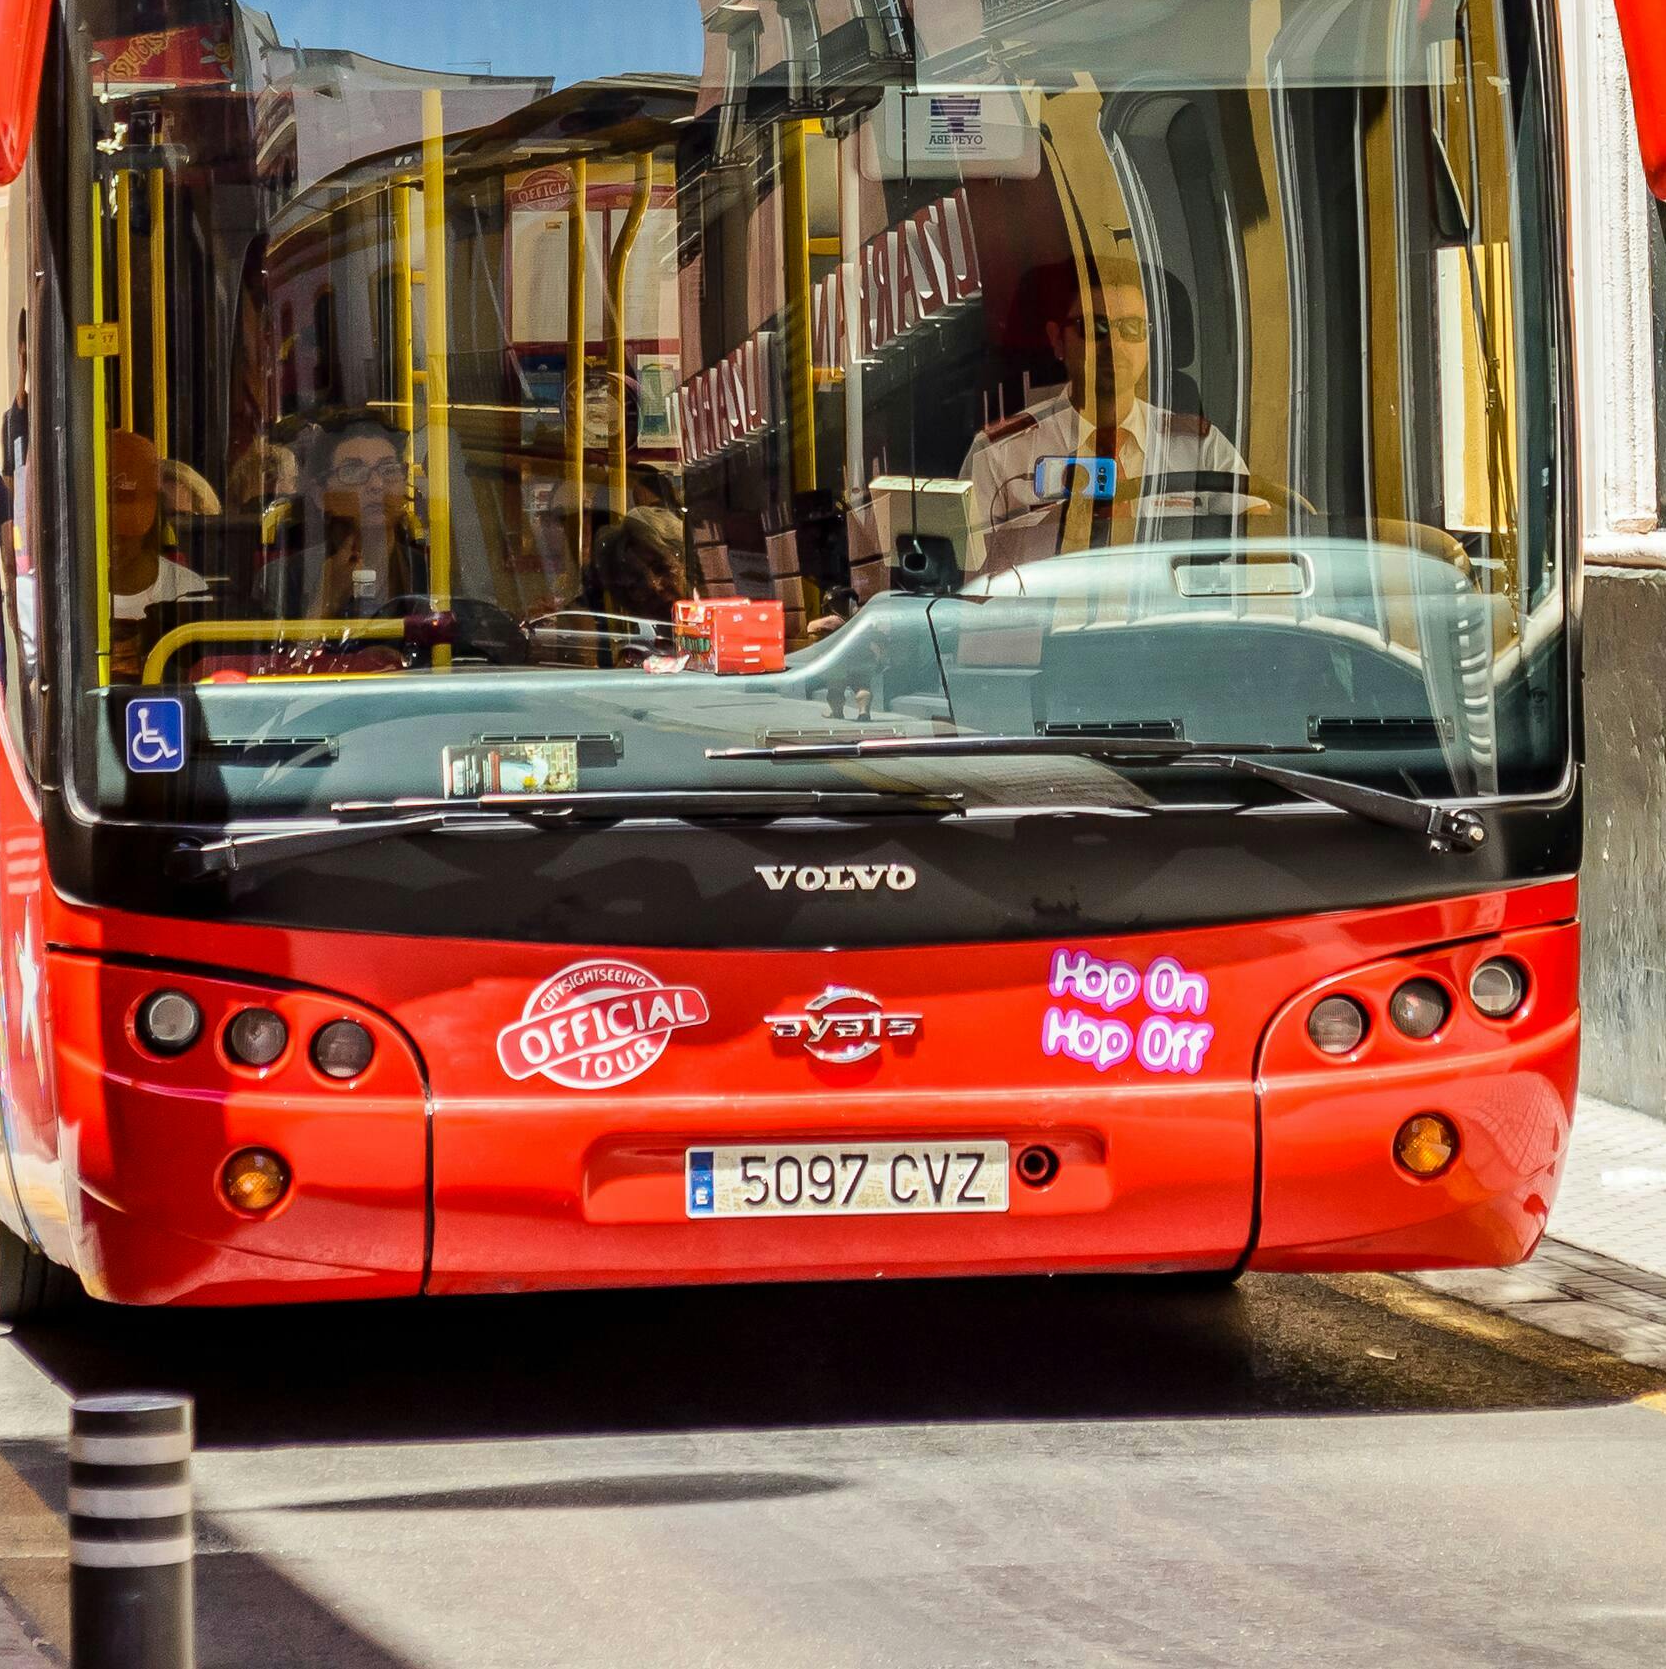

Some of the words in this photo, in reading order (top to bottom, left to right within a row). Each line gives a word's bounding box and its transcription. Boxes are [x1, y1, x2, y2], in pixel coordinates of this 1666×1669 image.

[928, 134, 983, 145] ASEPEYO
[754, 864, 917, 891] VOLVO
[539, 968, 647, 1012] CITYSIGHTSEEING
[1053, 953, 1138, 1008] Hop
[1148, 961, 1205, 1011] On
[519, 992, 697, 1065] OFFICIAL
[1046, 1011, 1130, 1067] Hop
[1141, 1020, 1210, 1070] Off
[578, 1037, 657, 1079] TOUR
[694, 1187, 708, 1206] E
[740, 1153, 870, 1206] 5097
[889, 1152, 986, 1205] CVZ
